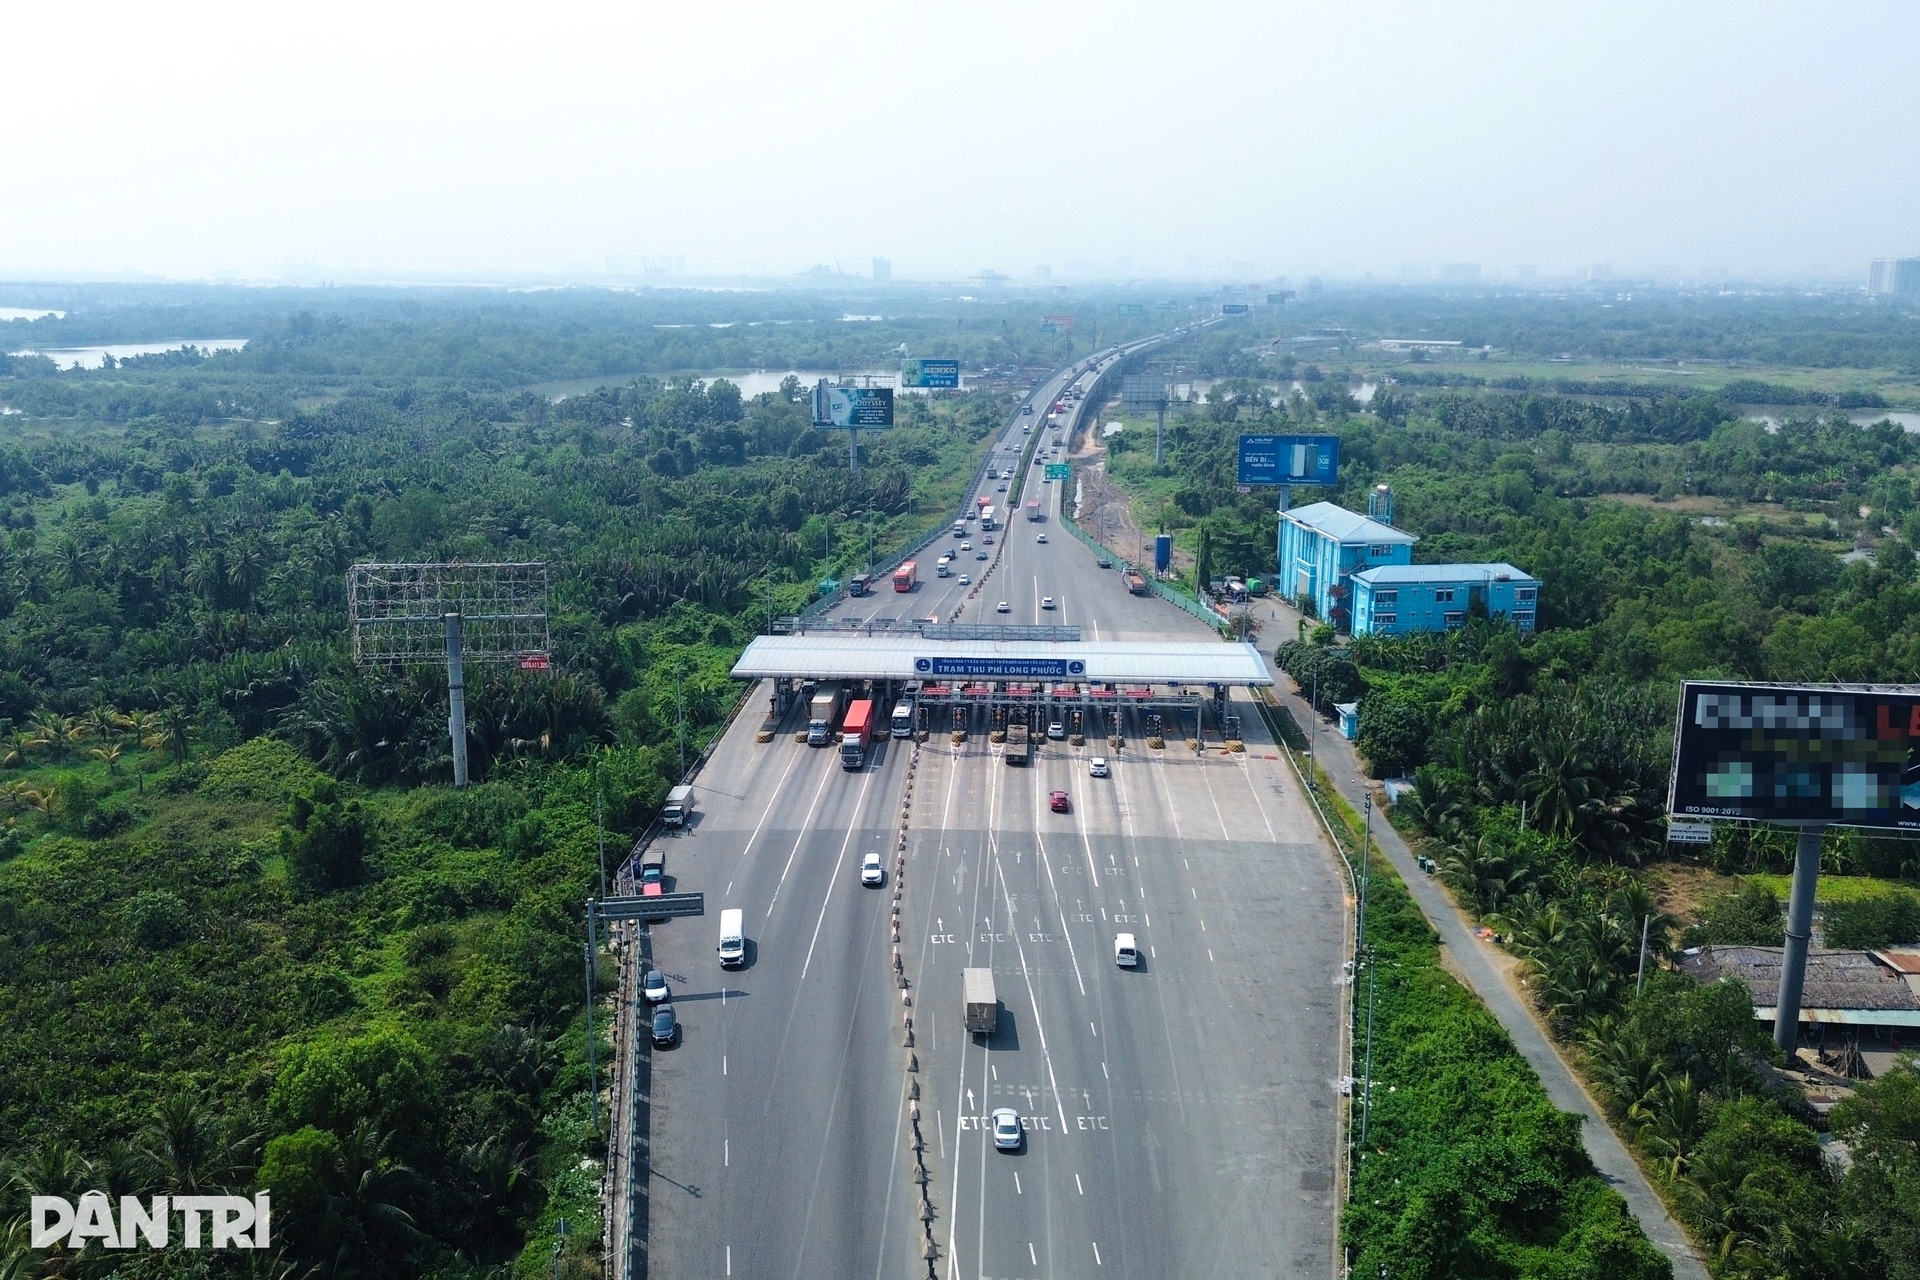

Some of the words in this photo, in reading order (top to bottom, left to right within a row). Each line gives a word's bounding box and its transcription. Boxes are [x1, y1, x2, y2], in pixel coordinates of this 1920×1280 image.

[938, 665, 964, 674] TRẠM
[988, 665, 1002, 673] PHÍ
[1031, 665, 1062, 674] PHƯỚC
[931, 934, 955, 944] ETC
[981, 934, 1004, 943] ETC
[1029, 933, 1053, 943] ETC
[961, 1116, 991, 1130] ETC
[1021, 1116, 1051, 1130] ETC
[1077, 1116, 1108, 1130] ETC
